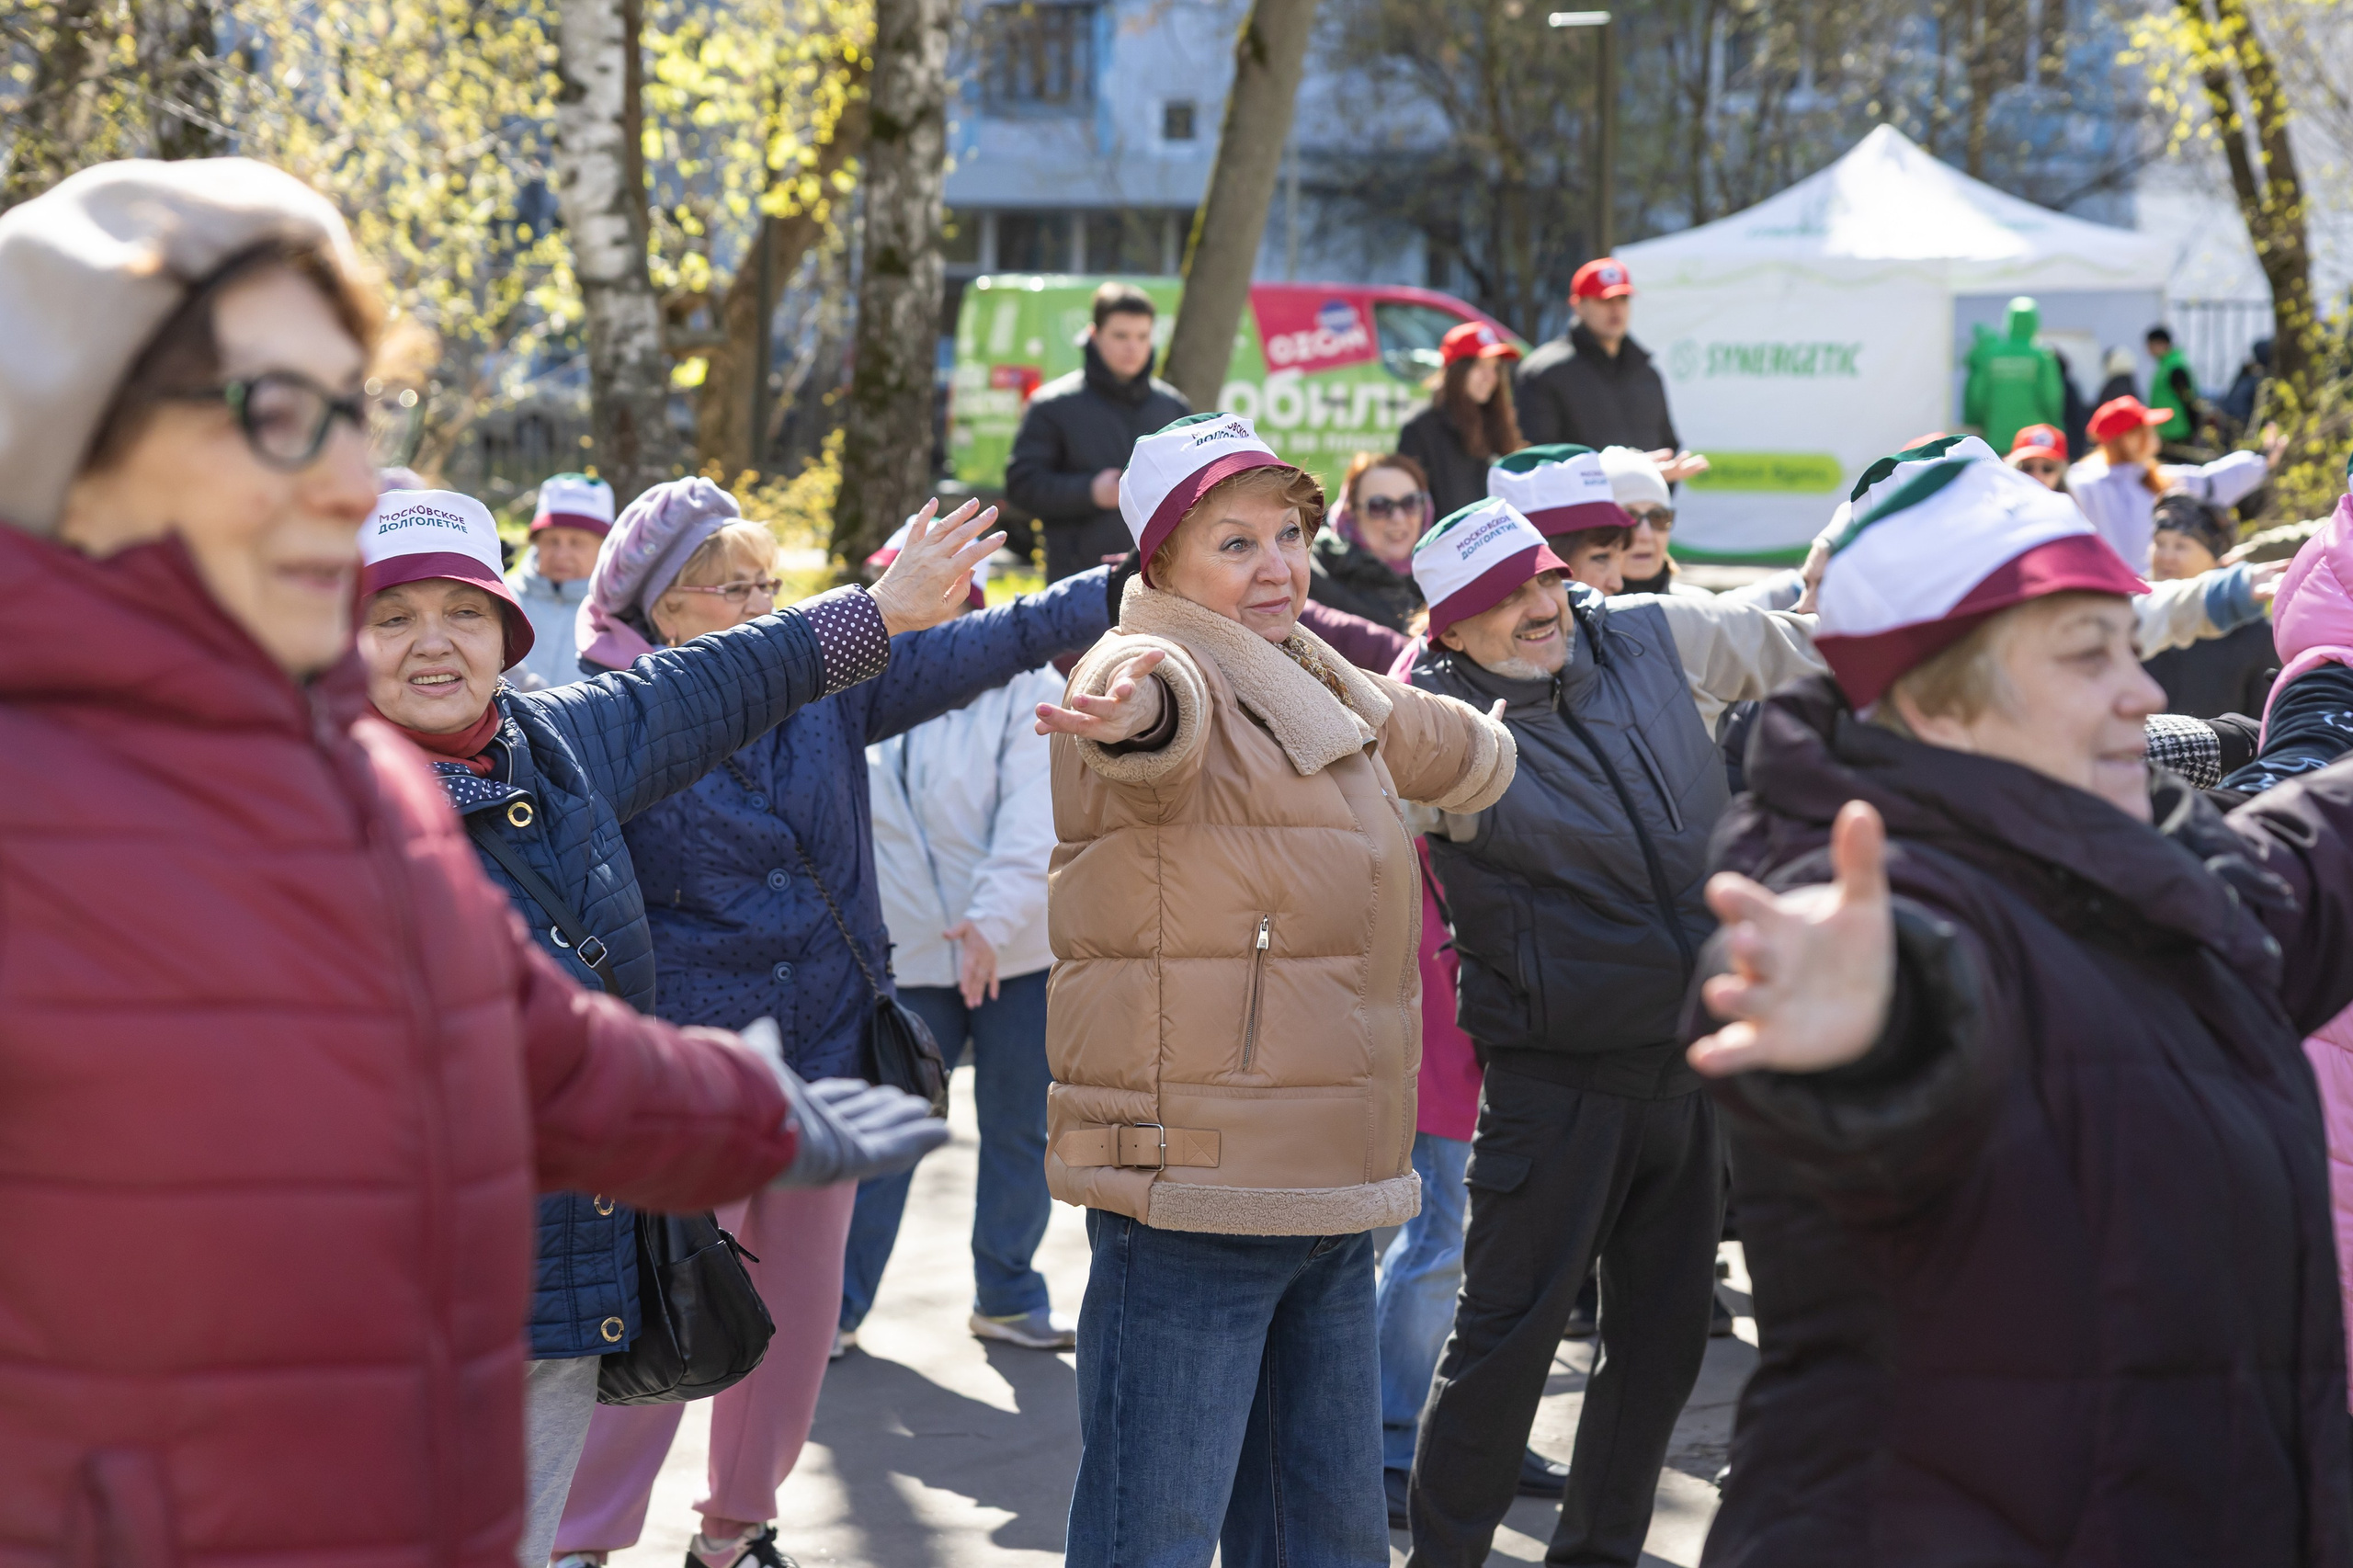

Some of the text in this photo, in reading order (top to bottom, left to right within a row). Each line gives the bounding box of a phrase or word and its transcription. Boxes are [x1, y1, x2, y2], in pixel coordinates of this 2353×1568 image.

[1705, 342, 1862, 379] SYNERGETIC
[378, 516, 469, 535] ДОЛГОЛЕТИЕ
[379, 505, 466, 525] МОСКОВСКОЕ
[1456, 515, 1512, 551] МОСКОВСКОЕ
[1461, 522, 1518, 561] ДОЛГОЛЕТИЕ
